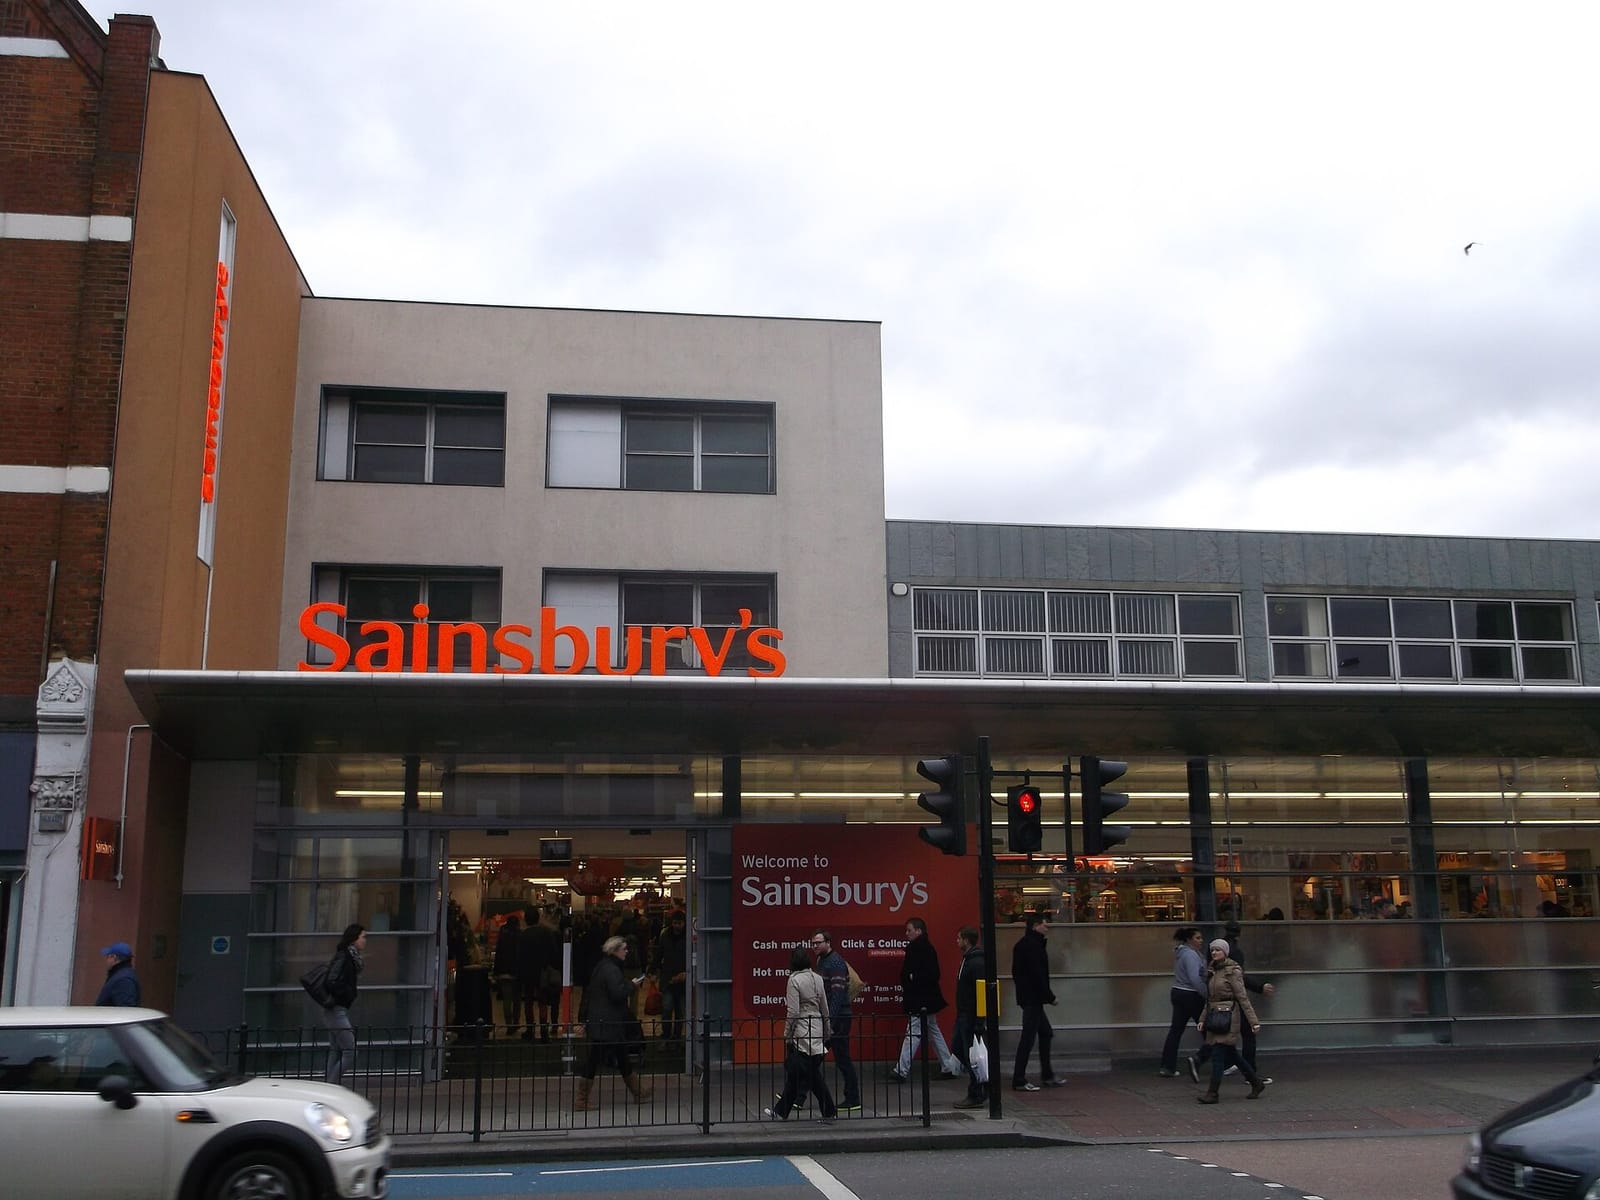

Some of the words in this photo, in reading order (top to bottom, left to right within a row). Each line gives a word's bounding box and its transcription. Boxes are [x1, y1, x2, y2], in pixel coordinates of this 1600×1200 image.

[298, 602, 786, 677] Sainsbury's
[742, 855, 809, 868] Welcome
[814, 855, 829, 868] to
[742, 875, 929, 912] Sainsbury's
[753, 940, 778, 949] Cash
[841, 939, 864, 948] Click
[867, 940, 875, 948] &
[752, 967, 772, 977] Hot
[775, 968, 793, 977] me
